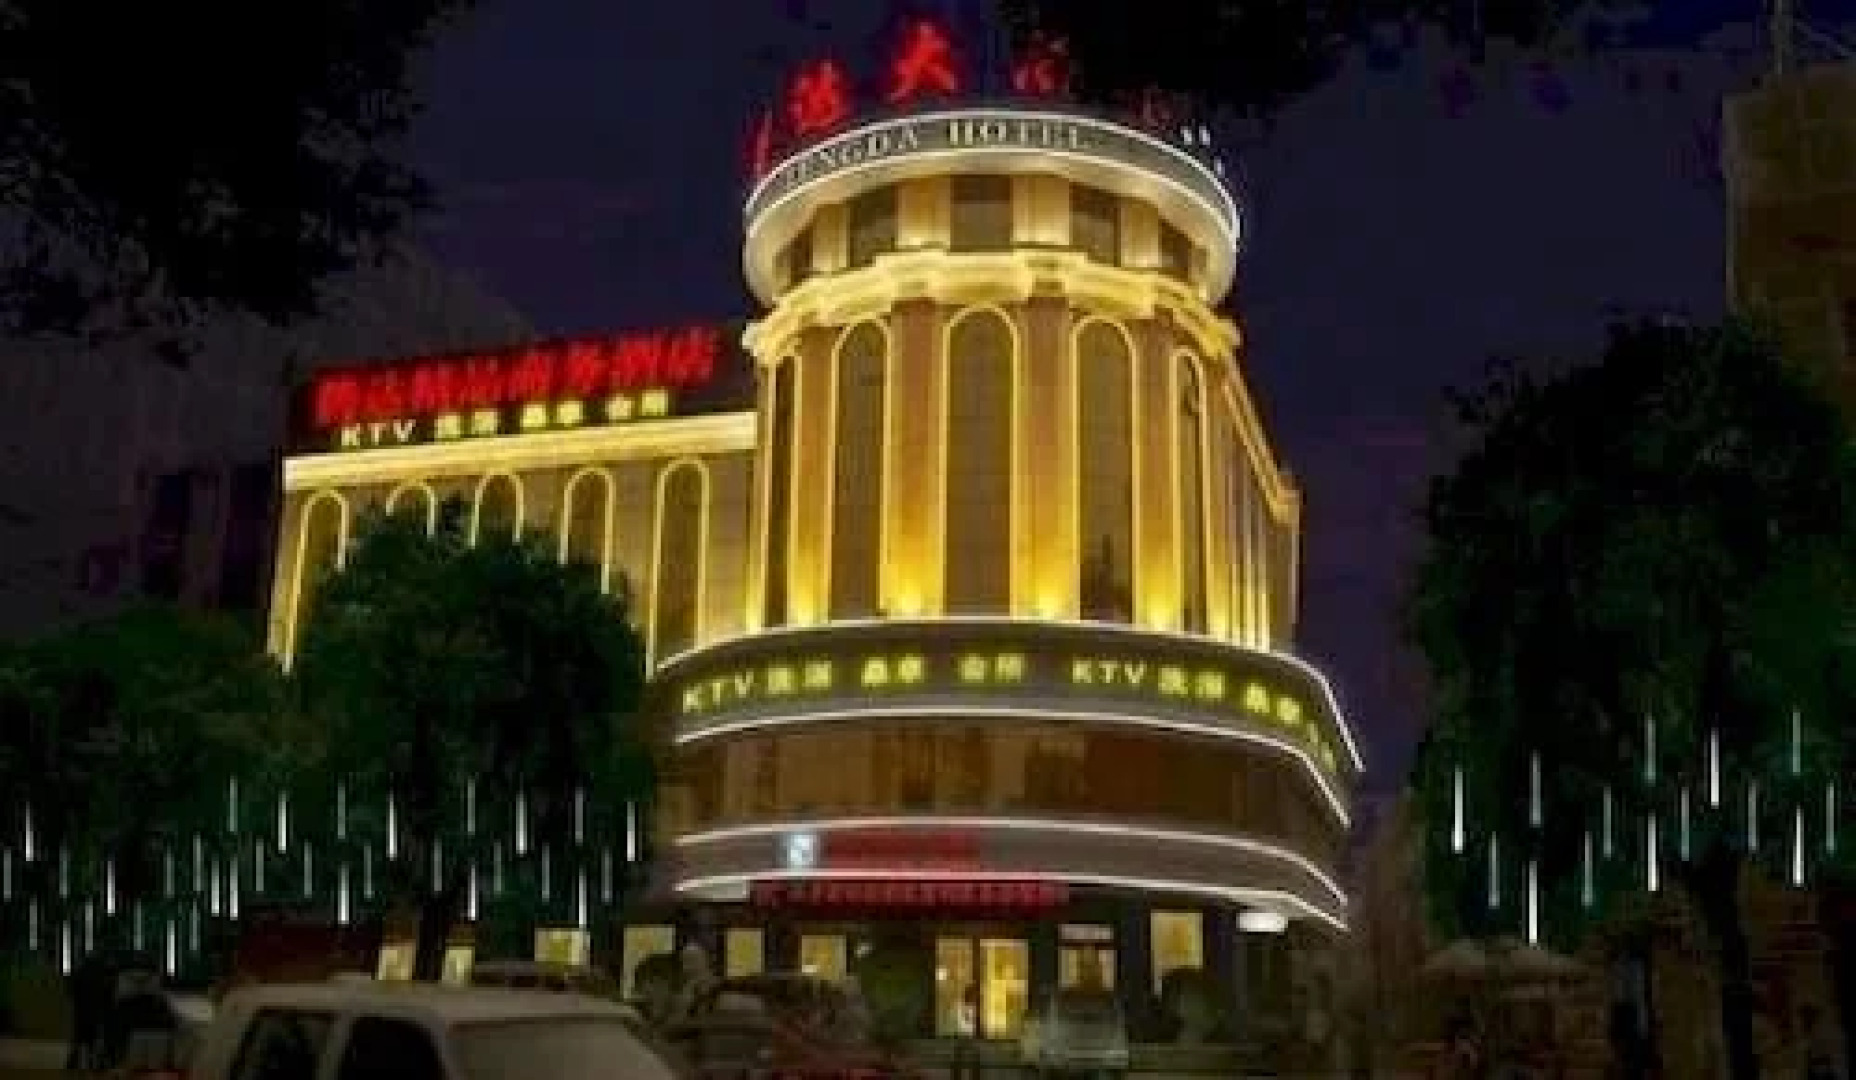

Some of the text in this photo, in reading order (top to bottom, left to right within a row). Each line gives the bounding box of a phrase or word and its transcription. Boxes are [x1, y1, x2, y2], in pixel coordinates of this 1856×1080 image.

[948, 117, 1090, 147] HOTEL
[340, 418, 416, 447] KTV
[1072, 660, 1147, 687] KTV
[683, 670, 753, 713] KTV
